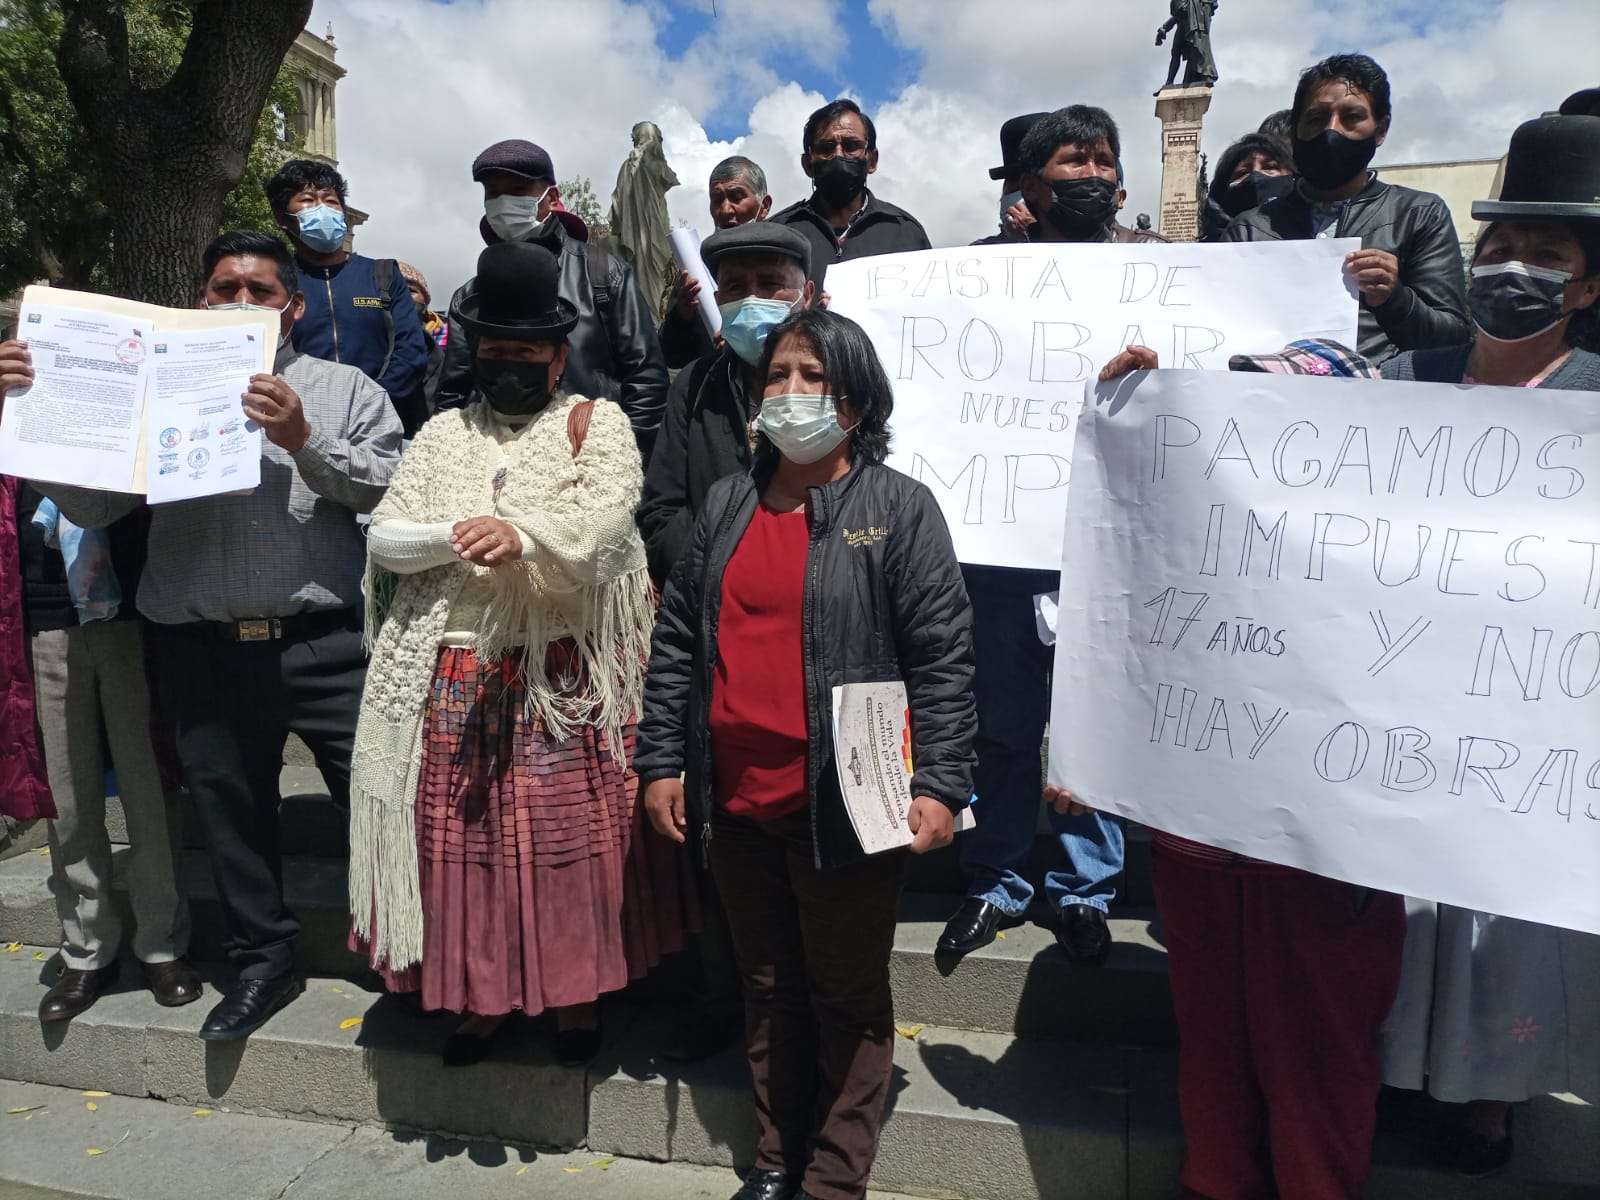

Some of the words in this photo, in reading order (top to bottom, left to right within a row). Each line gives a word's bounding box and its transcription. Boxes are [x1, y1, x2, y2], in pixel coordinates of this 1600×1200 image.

[867, 256, 1072, 301] BASTA
[1119, 262, 1201, 306] DE
[960, 391, 1084, 432] NUES
[1152, 414, 1585, 499] PAGAMOS
[1144, 587, 1210, 650] 17
[1206, 616, 1286, 657] AÑOS
[1368, 608, 1432, 677] Y
[1465, 625, 1600, 701] NO
[877, 702, 888, 746] mundo
[886, 720, 895, 748] Vida
[1150, 683, 1289, 760] HAY
[881, 750, 890, 761] el
[891, 751, 898, 762] la
[885, 764, 907, 821] Pensando
[894, 765, 908, 800] desde
